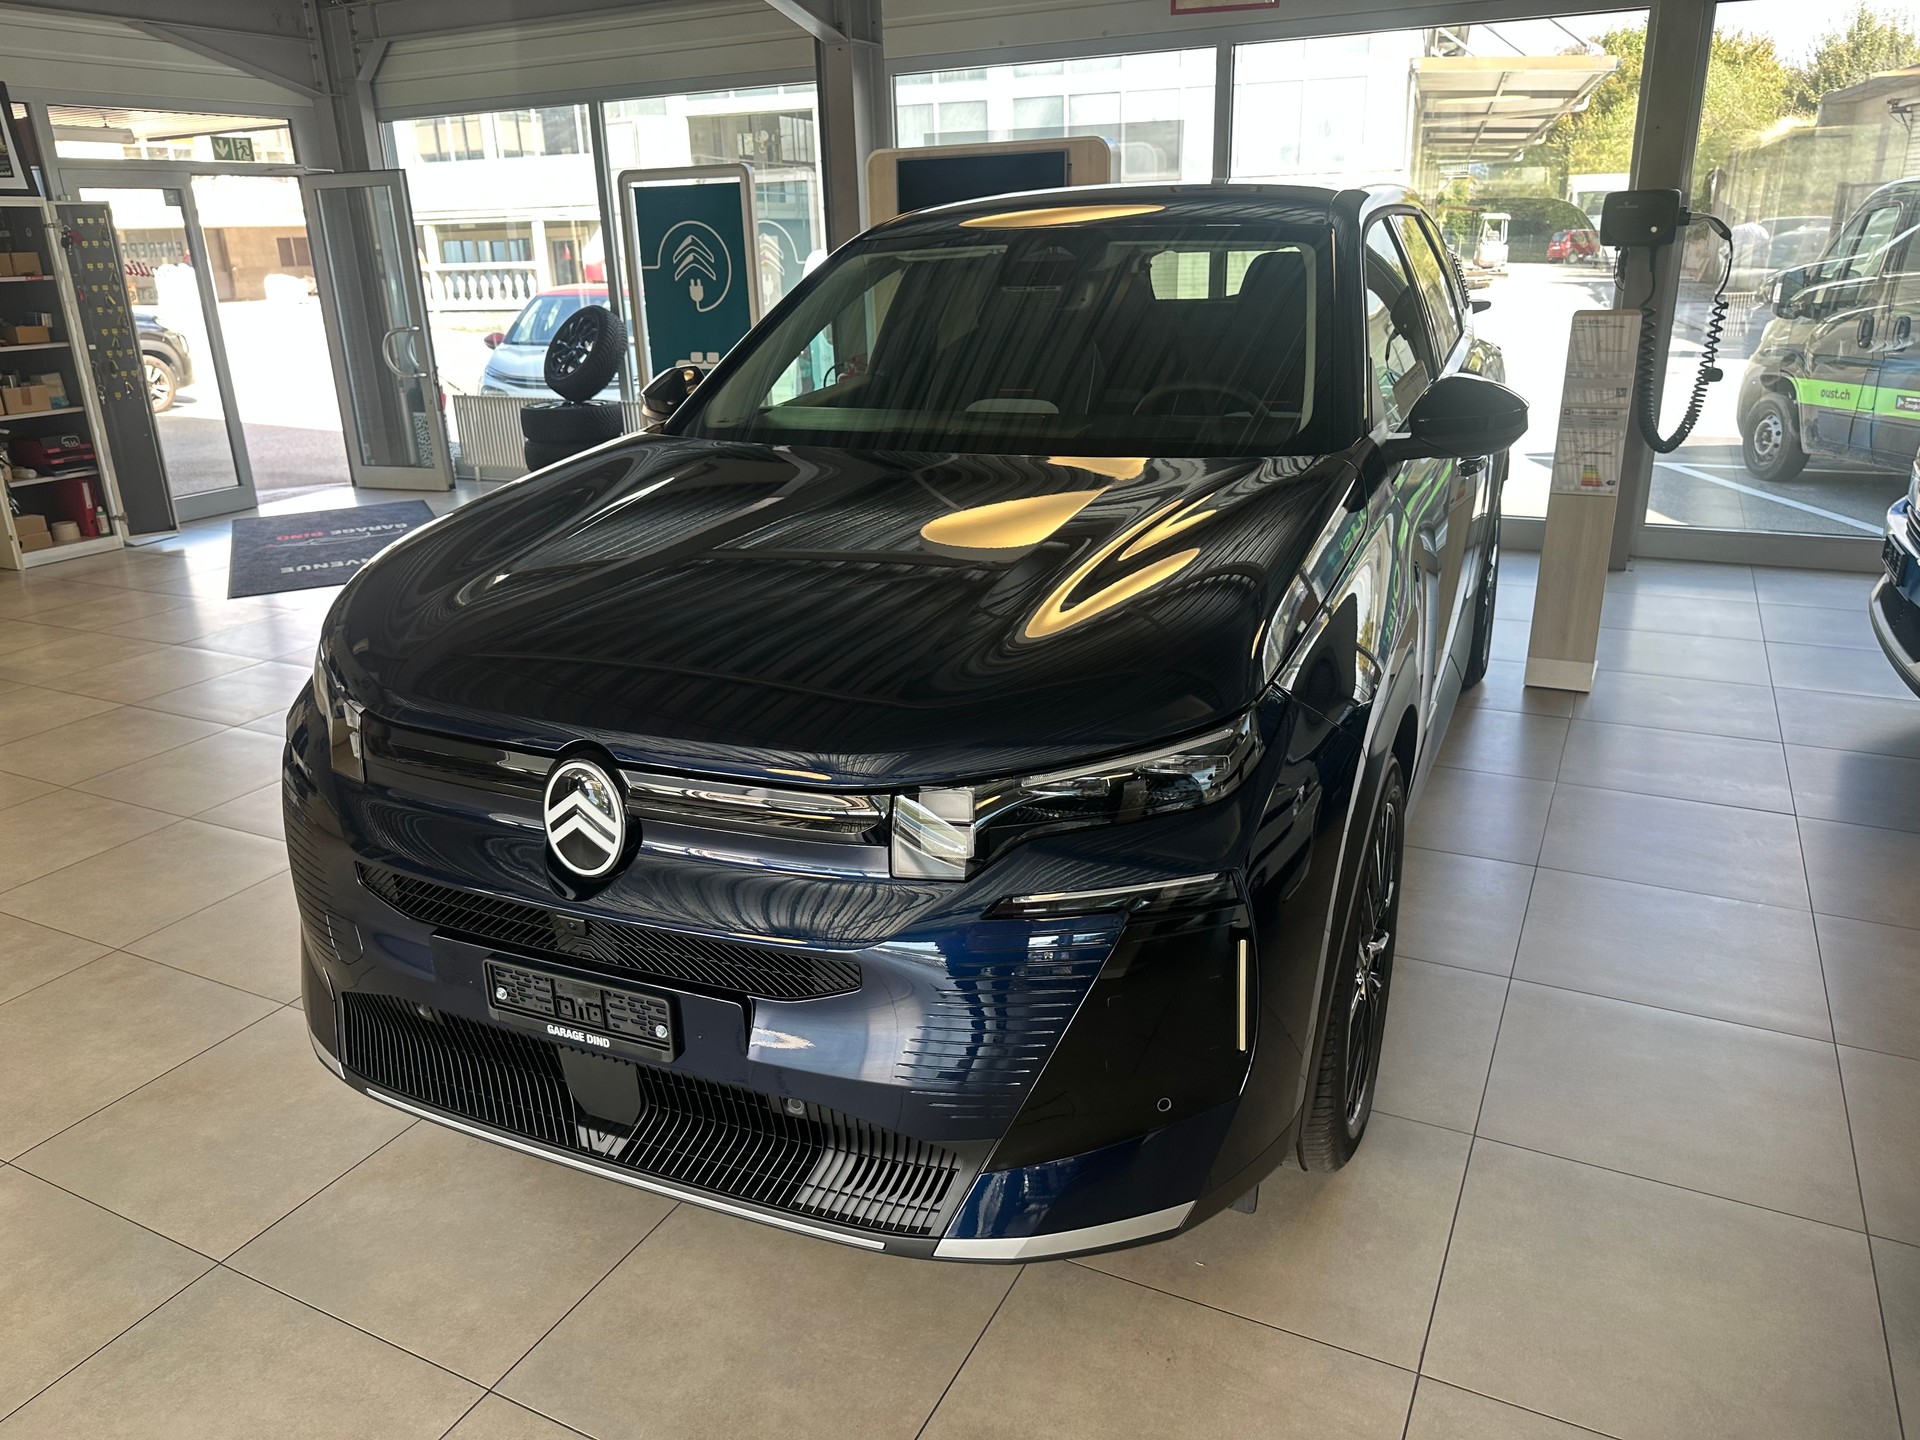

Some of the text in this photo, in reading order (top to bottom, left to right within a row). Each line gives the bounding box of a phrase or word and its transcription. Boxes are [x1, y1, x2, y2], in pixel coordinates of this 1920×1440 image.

[1820, 388, 1851, 401] oust.ch
[330, 522, 408, 536] GARAGE
[546, 1024, 610, 1048] GARAGE DIND
